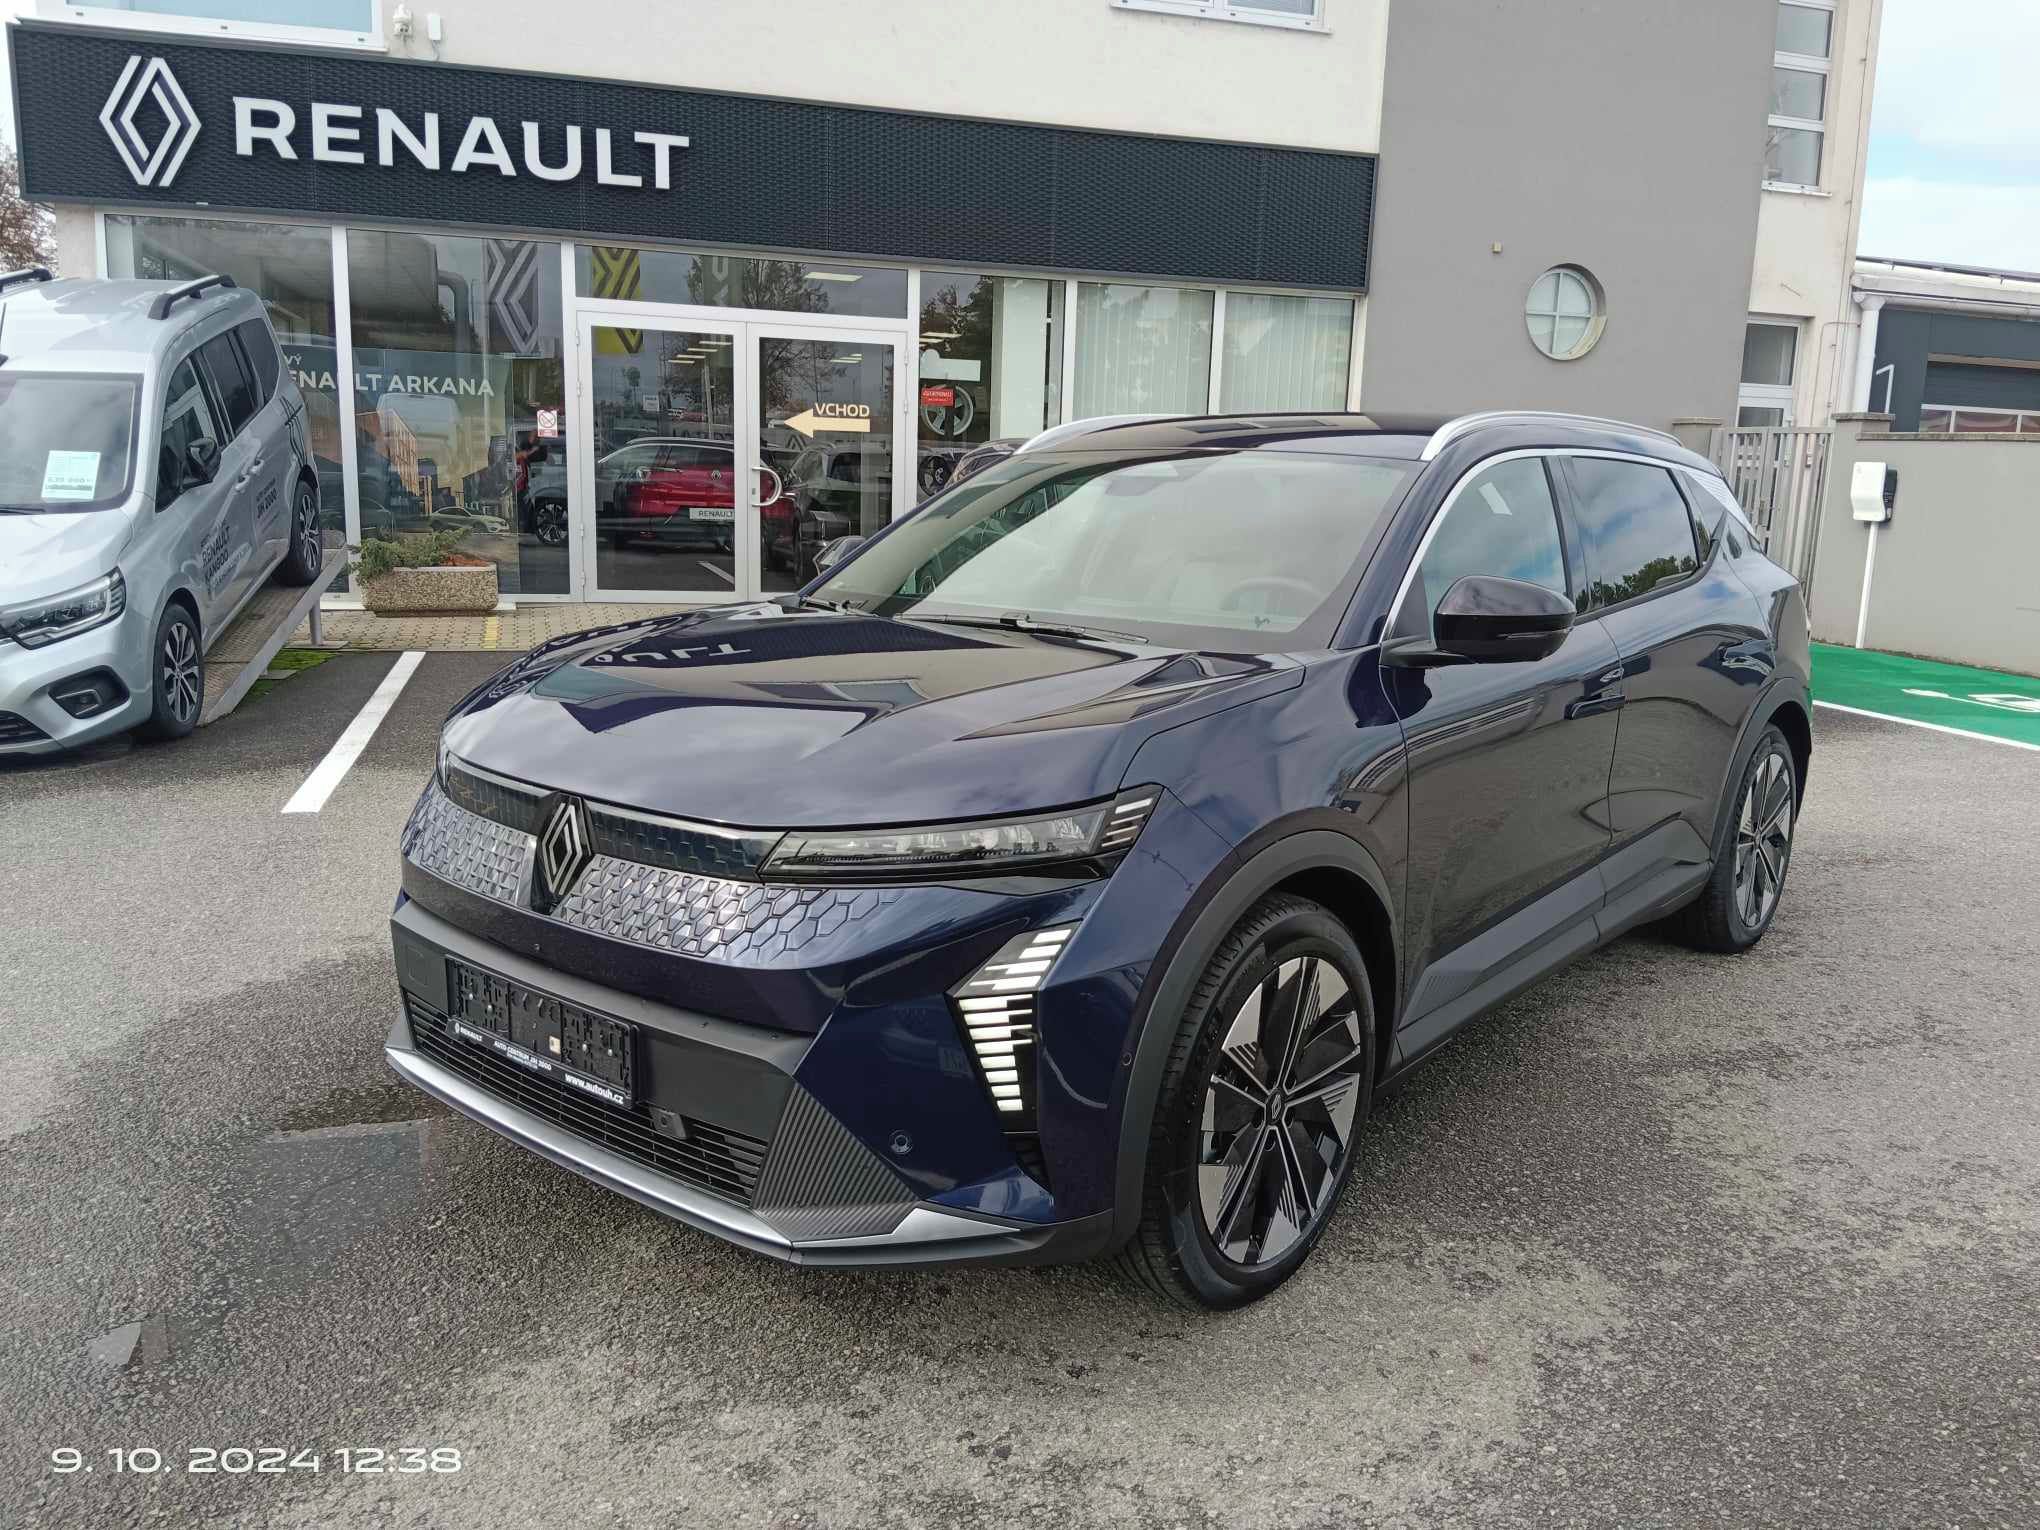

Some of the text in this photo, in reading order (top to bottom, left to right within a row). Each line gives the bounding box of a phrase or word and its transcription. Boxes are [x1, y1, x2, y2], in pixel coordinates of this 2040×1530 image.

[232, 96, 690, 190] RENAULT
[285, 353, 302, 365] VÝ
[288, 370, 495, 397] NALT ARKANA
[815, 402, 870, 417] VCHOD
[202, 525, 231, 569] RENAULT
[565, 1073, 624, 1105] www.autouh.cz
